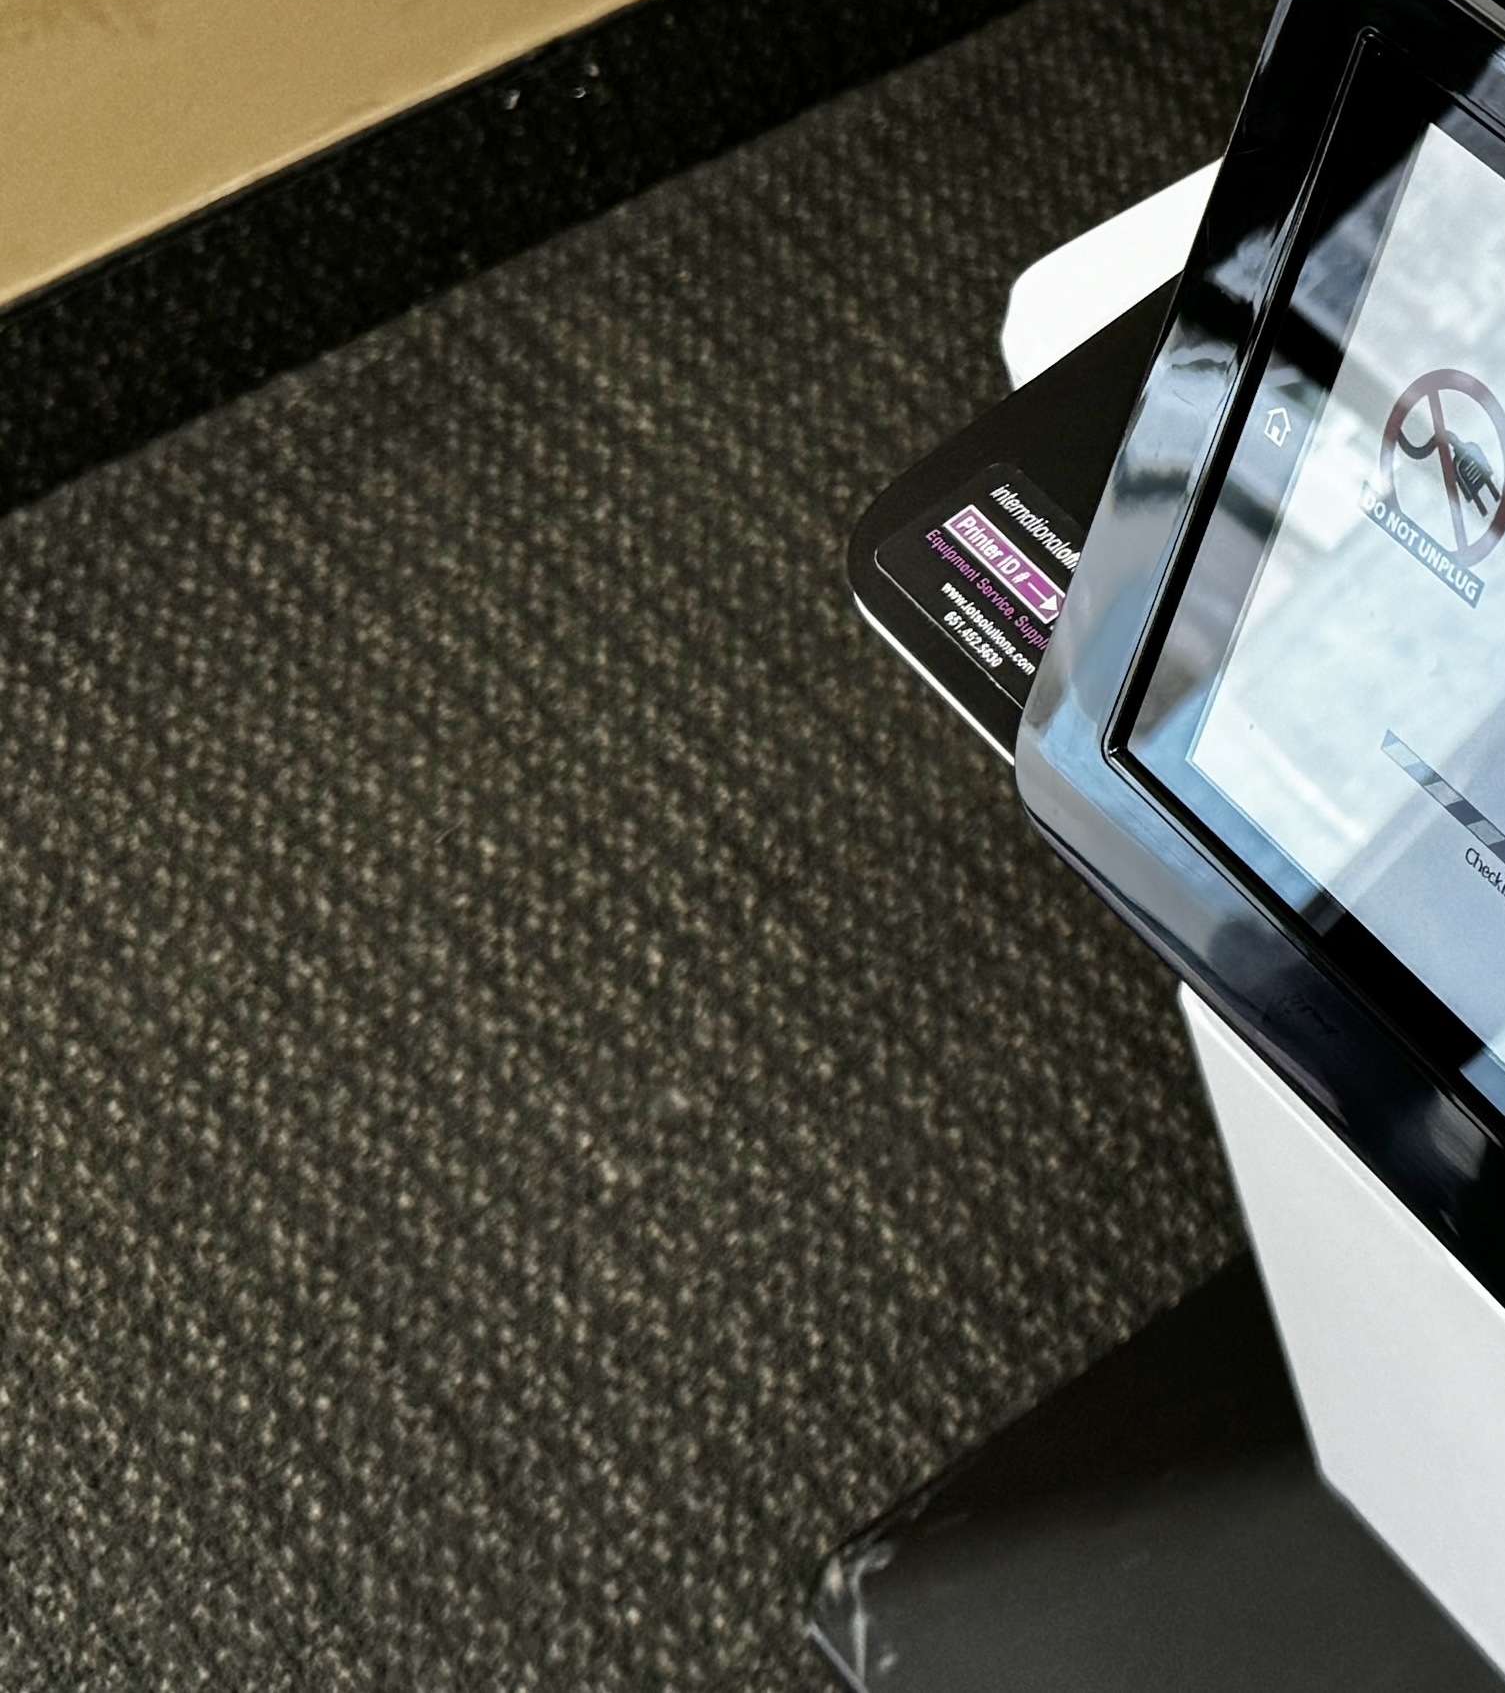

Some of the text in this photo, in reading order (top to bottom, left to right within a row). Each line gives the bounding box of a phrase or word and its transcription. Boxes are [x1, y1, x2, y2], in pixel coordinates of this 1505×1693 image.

[956, 515, 1005, 561] Printer
[997, 555, 1021, 576] ID
[989, 483, 1081, 573] internationaloffi
[1362, 493, 1480, 601] DO NOT UNPLUG
[925, 528, 981, 583] Equipment
[976, 576, 1015, 620] Service,
